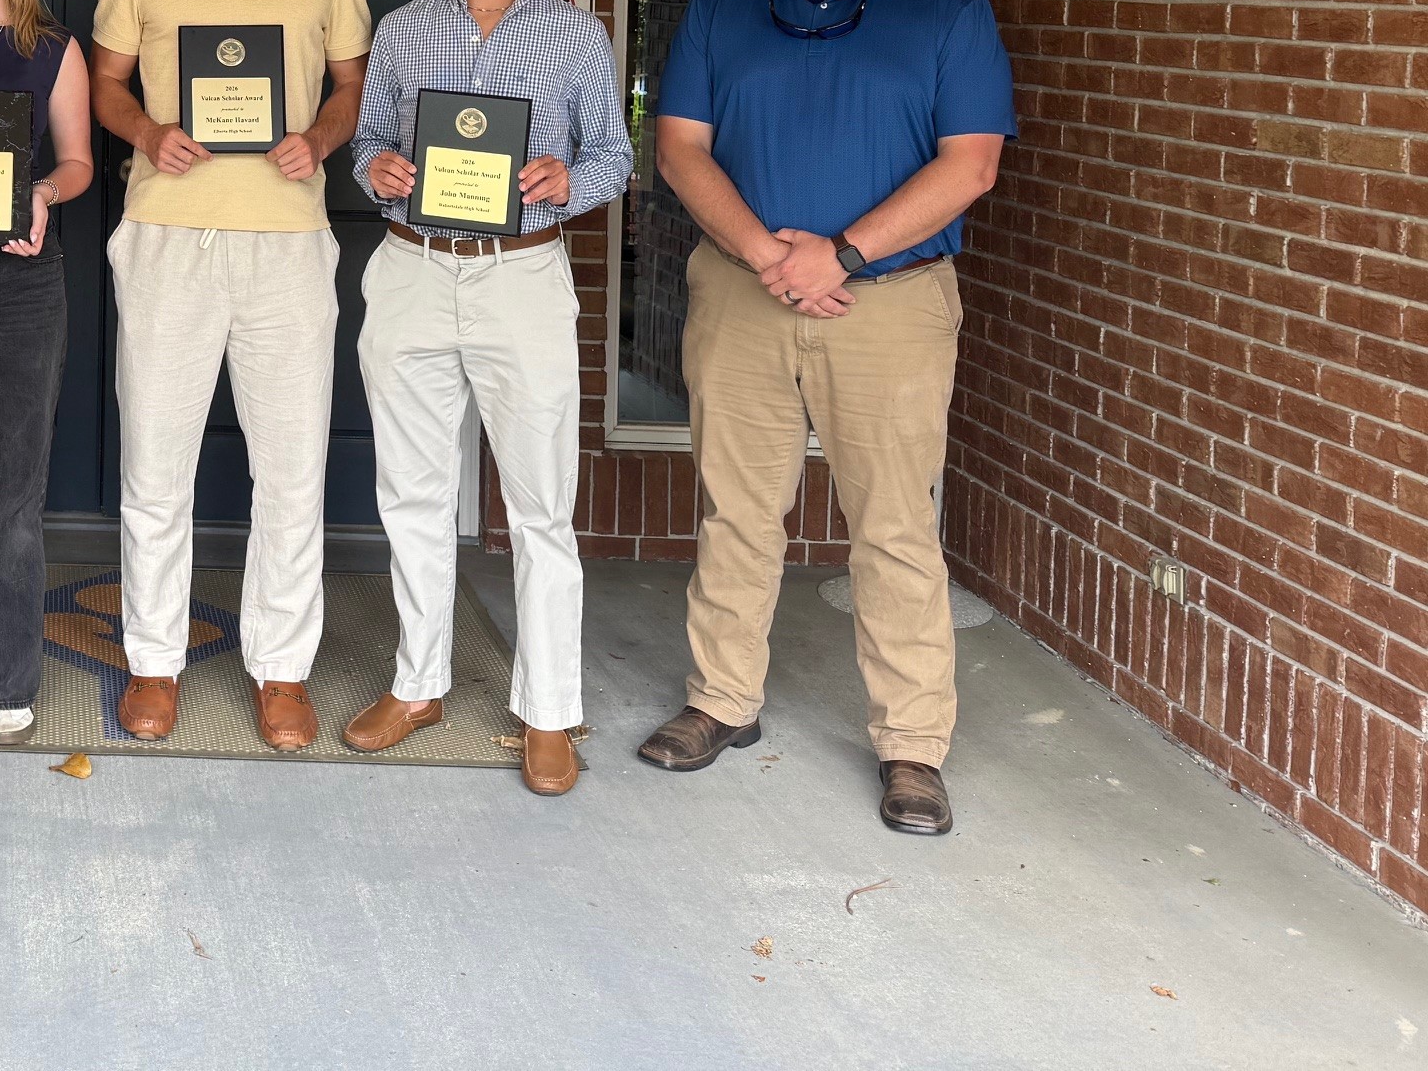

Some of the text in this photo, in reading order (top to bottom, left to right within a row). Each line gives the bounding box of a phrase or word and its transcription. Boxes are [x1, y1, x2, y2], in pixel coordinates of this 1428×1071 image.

[456, 169, 479, 177] Scholar
[440, 189, 491, 203] John Manning
